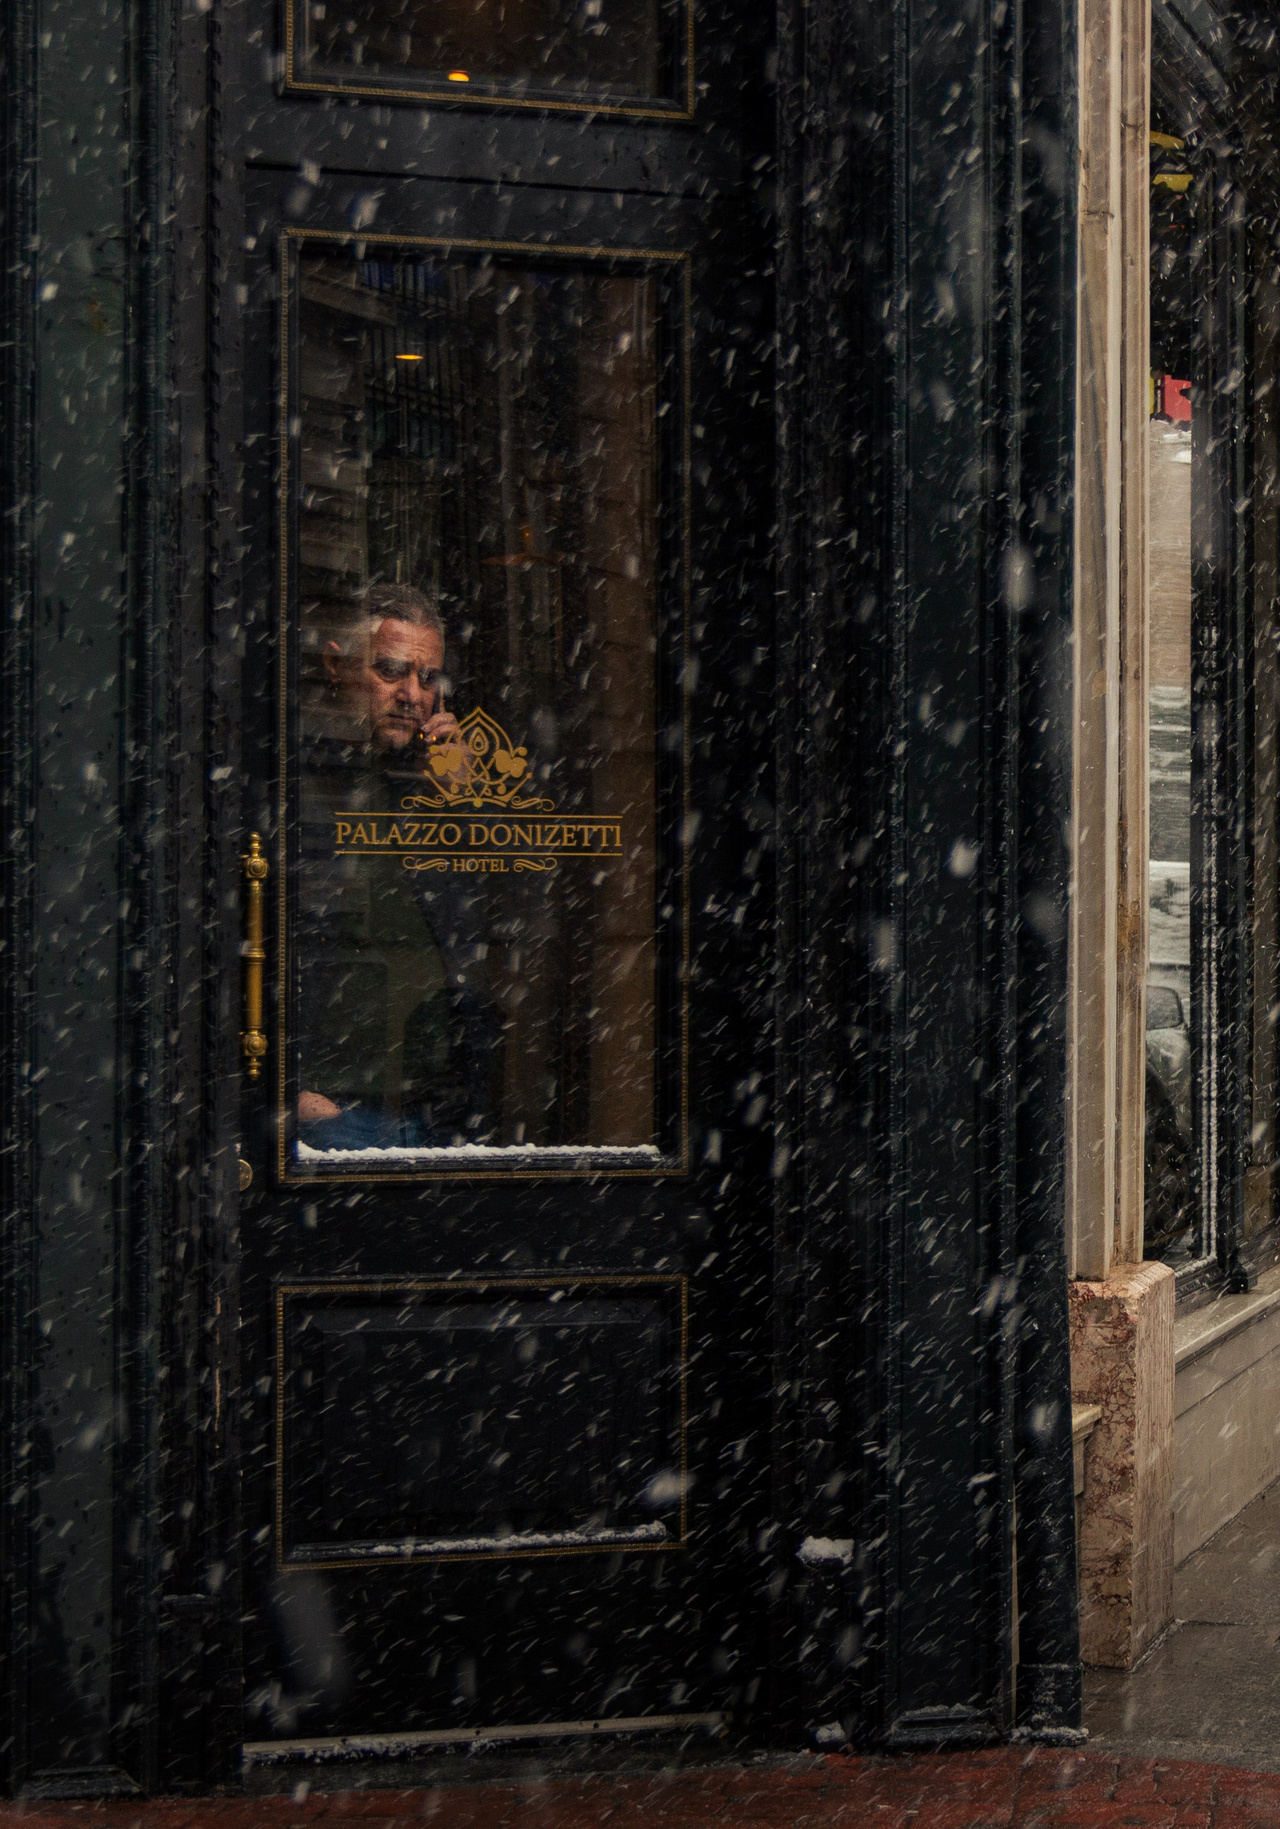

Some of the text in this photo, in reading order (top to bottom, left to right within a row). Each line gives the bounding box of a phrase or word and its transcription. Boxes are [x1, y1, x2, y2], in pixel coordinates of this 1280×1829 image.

[335, 822, 623, 847] PALAZZO DONIZETTI
[453, 858, 509, 873] HOTEL
